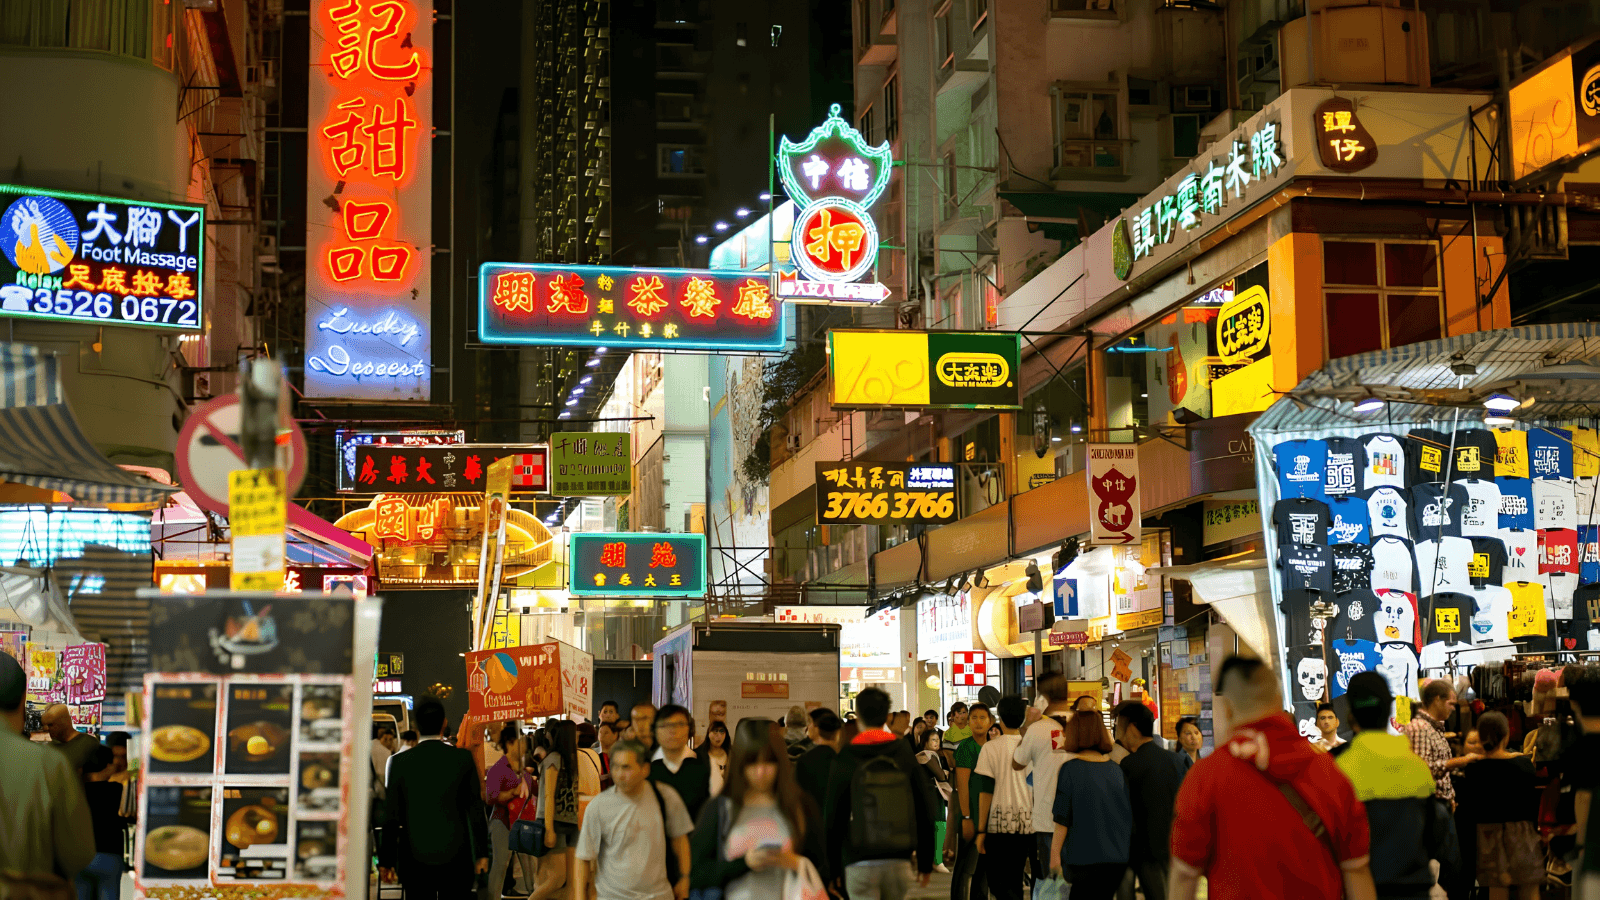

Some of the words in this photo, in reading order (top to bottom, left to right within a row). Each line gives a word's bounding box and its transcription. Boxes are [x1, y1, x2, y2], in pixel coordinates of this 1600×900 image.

[81, 203, 199, 253] 大腳丫
[807, 208, 865, 271] 押
[81, 243, 121, 262] Foot
[125, 246, 197, 271] Massage
[63, 264, 196, 299] 足底按摩
[33, 289, 113, 318] 3526
[121, 295, 197, 325] 0672
[823, 492, 889, 518] 3766
[890, 492, 954, 518] 3766
